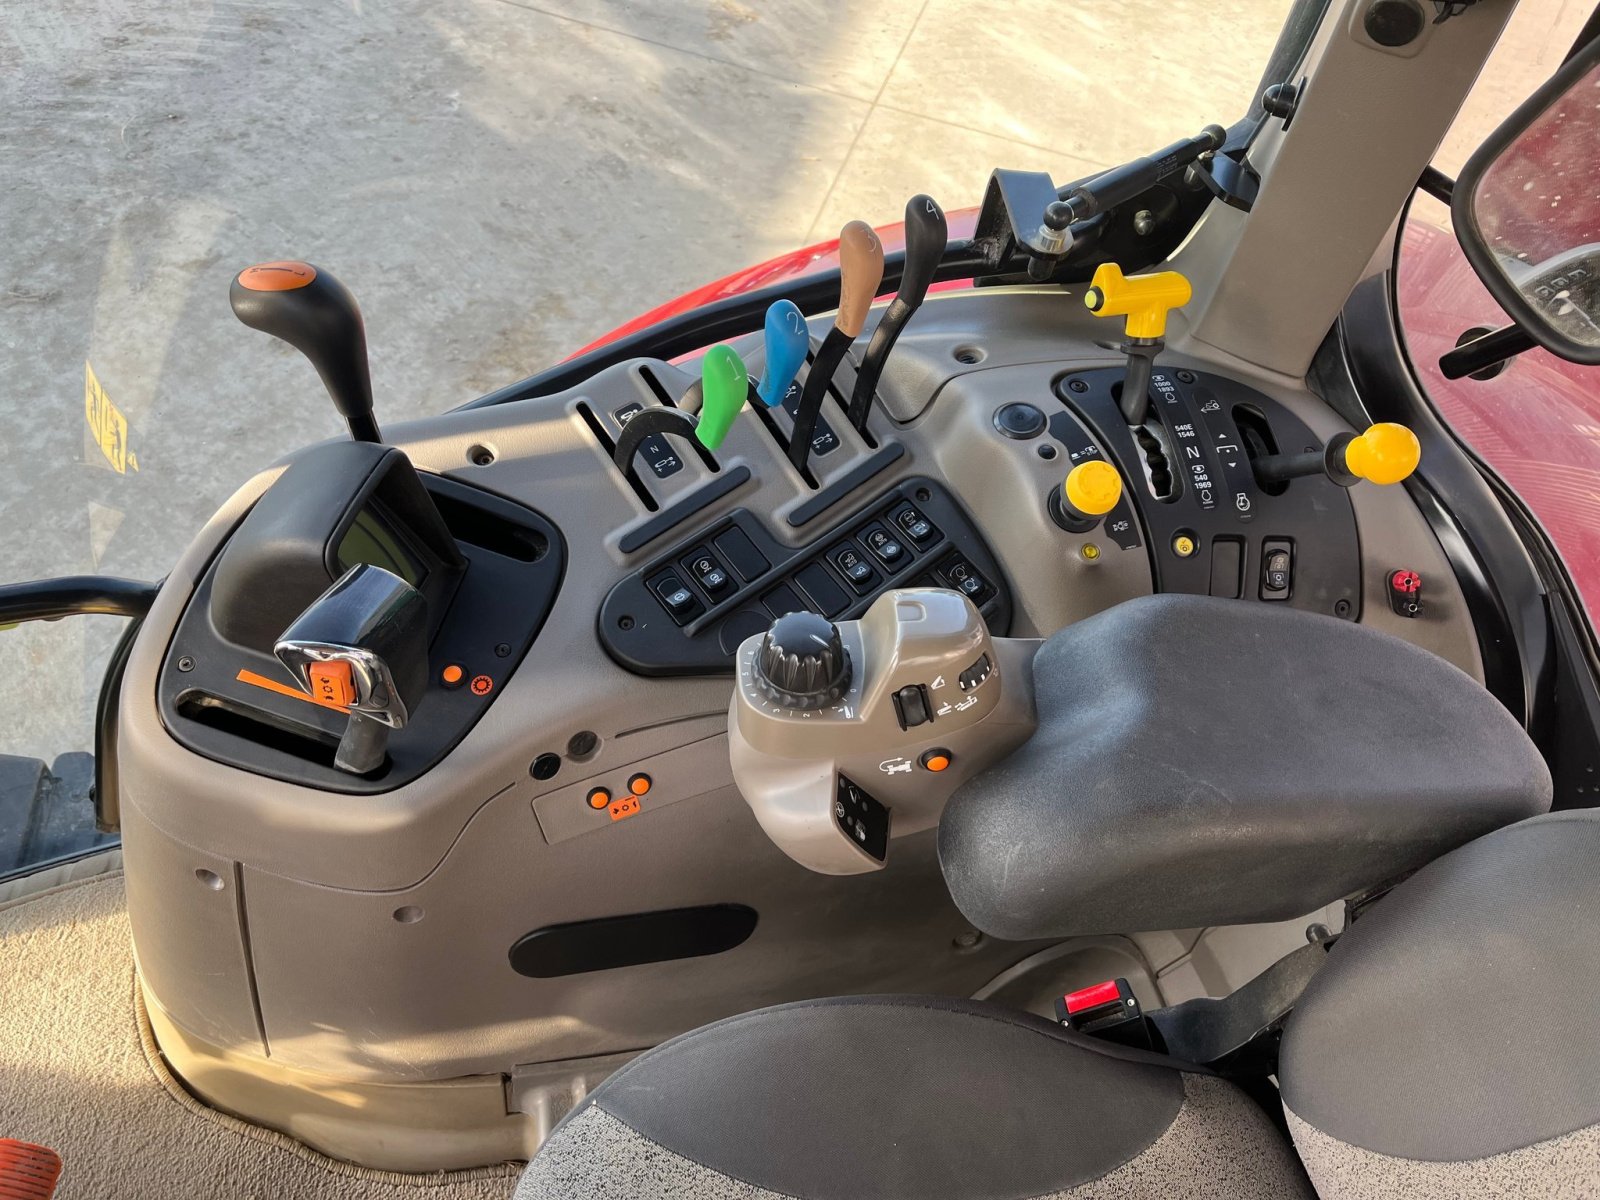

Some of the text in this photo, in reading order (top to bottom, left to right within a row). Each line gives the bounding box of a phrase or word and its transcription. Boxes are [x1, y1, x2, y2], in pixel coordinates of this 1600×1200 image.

[926, 199, 939, 220] 4
[860, 228, 877, 252] 3
[786, 311, 804, 335] 2
[726, 356, 741, 381] 1
[1154, 380, 1171, 388] 1000
[1175, 423, 1193, 432] 540E
[1177, 430, 1195, 438] 1546
[650, 444, 659, 454] N
[1186, 445, 1200, 459] N
[1194, 474, 1208, 482] 540
[1194, 481, 1212, 490] 1969
